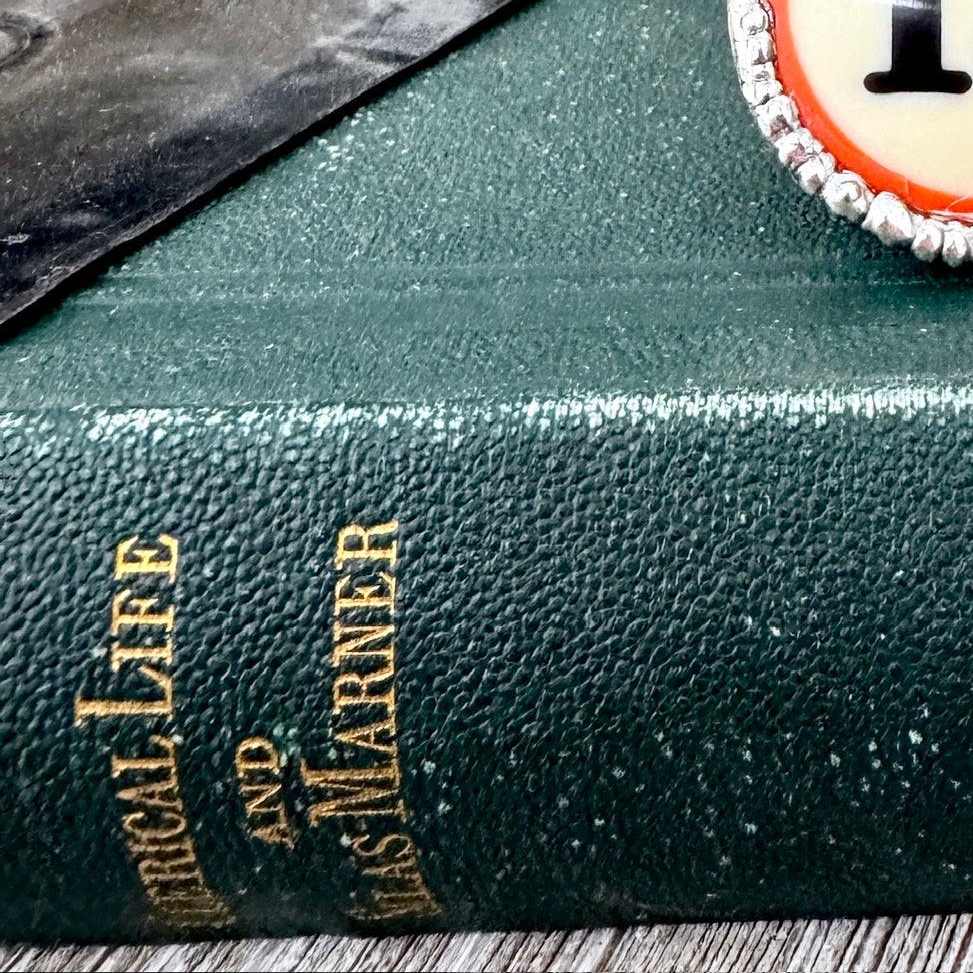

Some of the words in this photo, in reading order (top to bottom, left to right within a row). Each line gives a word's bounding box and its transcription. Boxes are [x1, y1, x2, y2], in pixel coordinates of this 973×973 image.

[74, 533, 179, 727] LIFE
[300, 519, 408, 826] MARNER
[236, 736, 296, 850] AND
